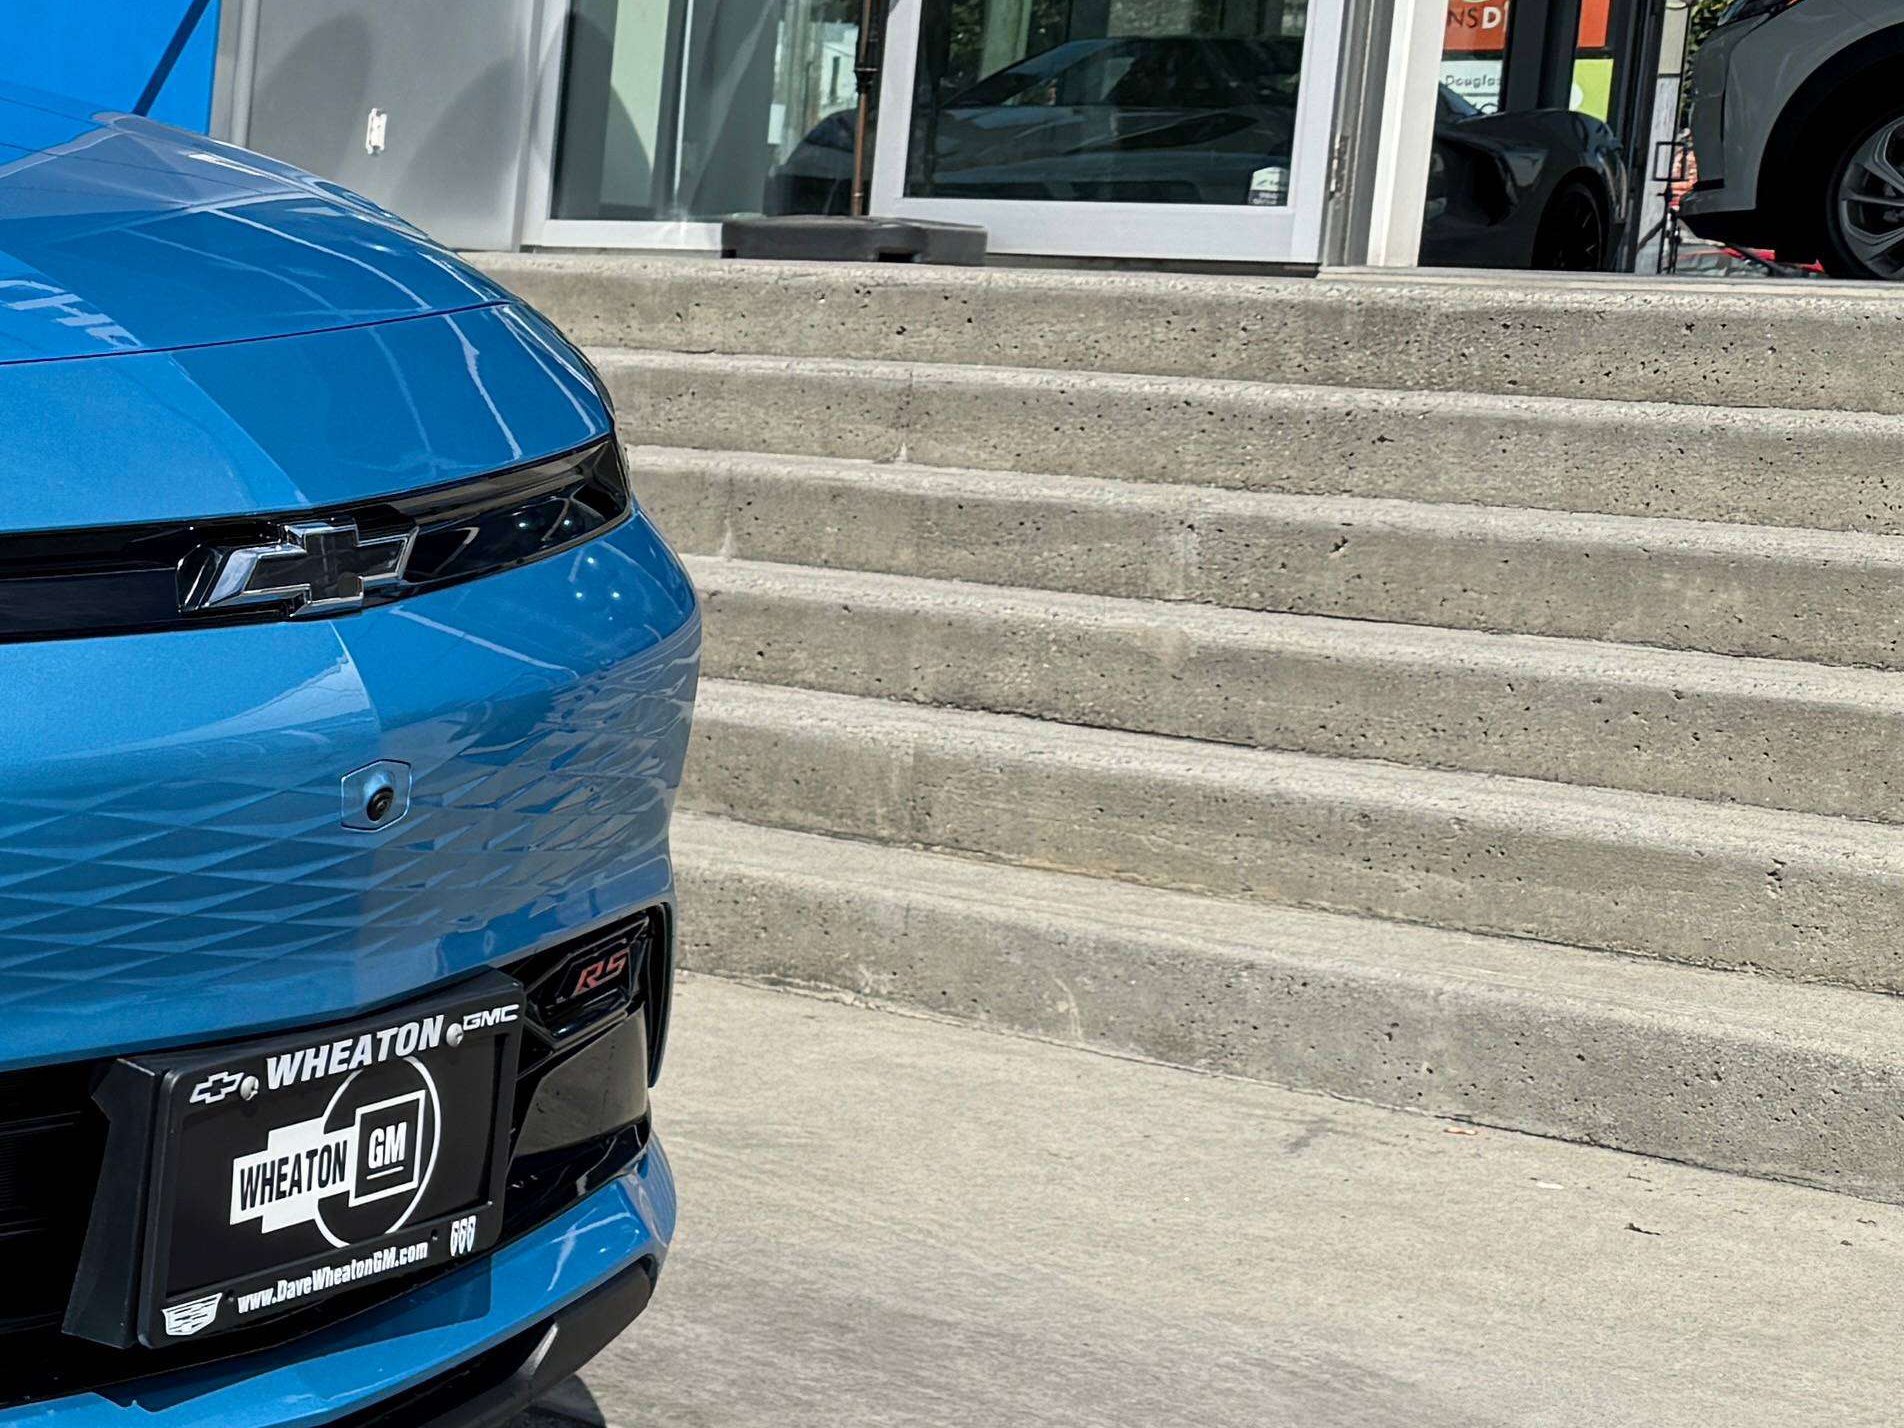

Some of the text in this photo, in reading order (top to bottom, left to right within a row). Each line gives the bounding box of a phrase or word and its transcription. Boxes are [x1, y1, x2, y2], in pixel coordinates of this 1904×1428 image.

[575, 948, 629, 995] RS
[266, 1004, 520, 1090] WHEATON GMC
[240, 1122, 408, 1212] WHEATON GM
[237, 1241, 429, 1314] www.DaveWheatonGM.com
